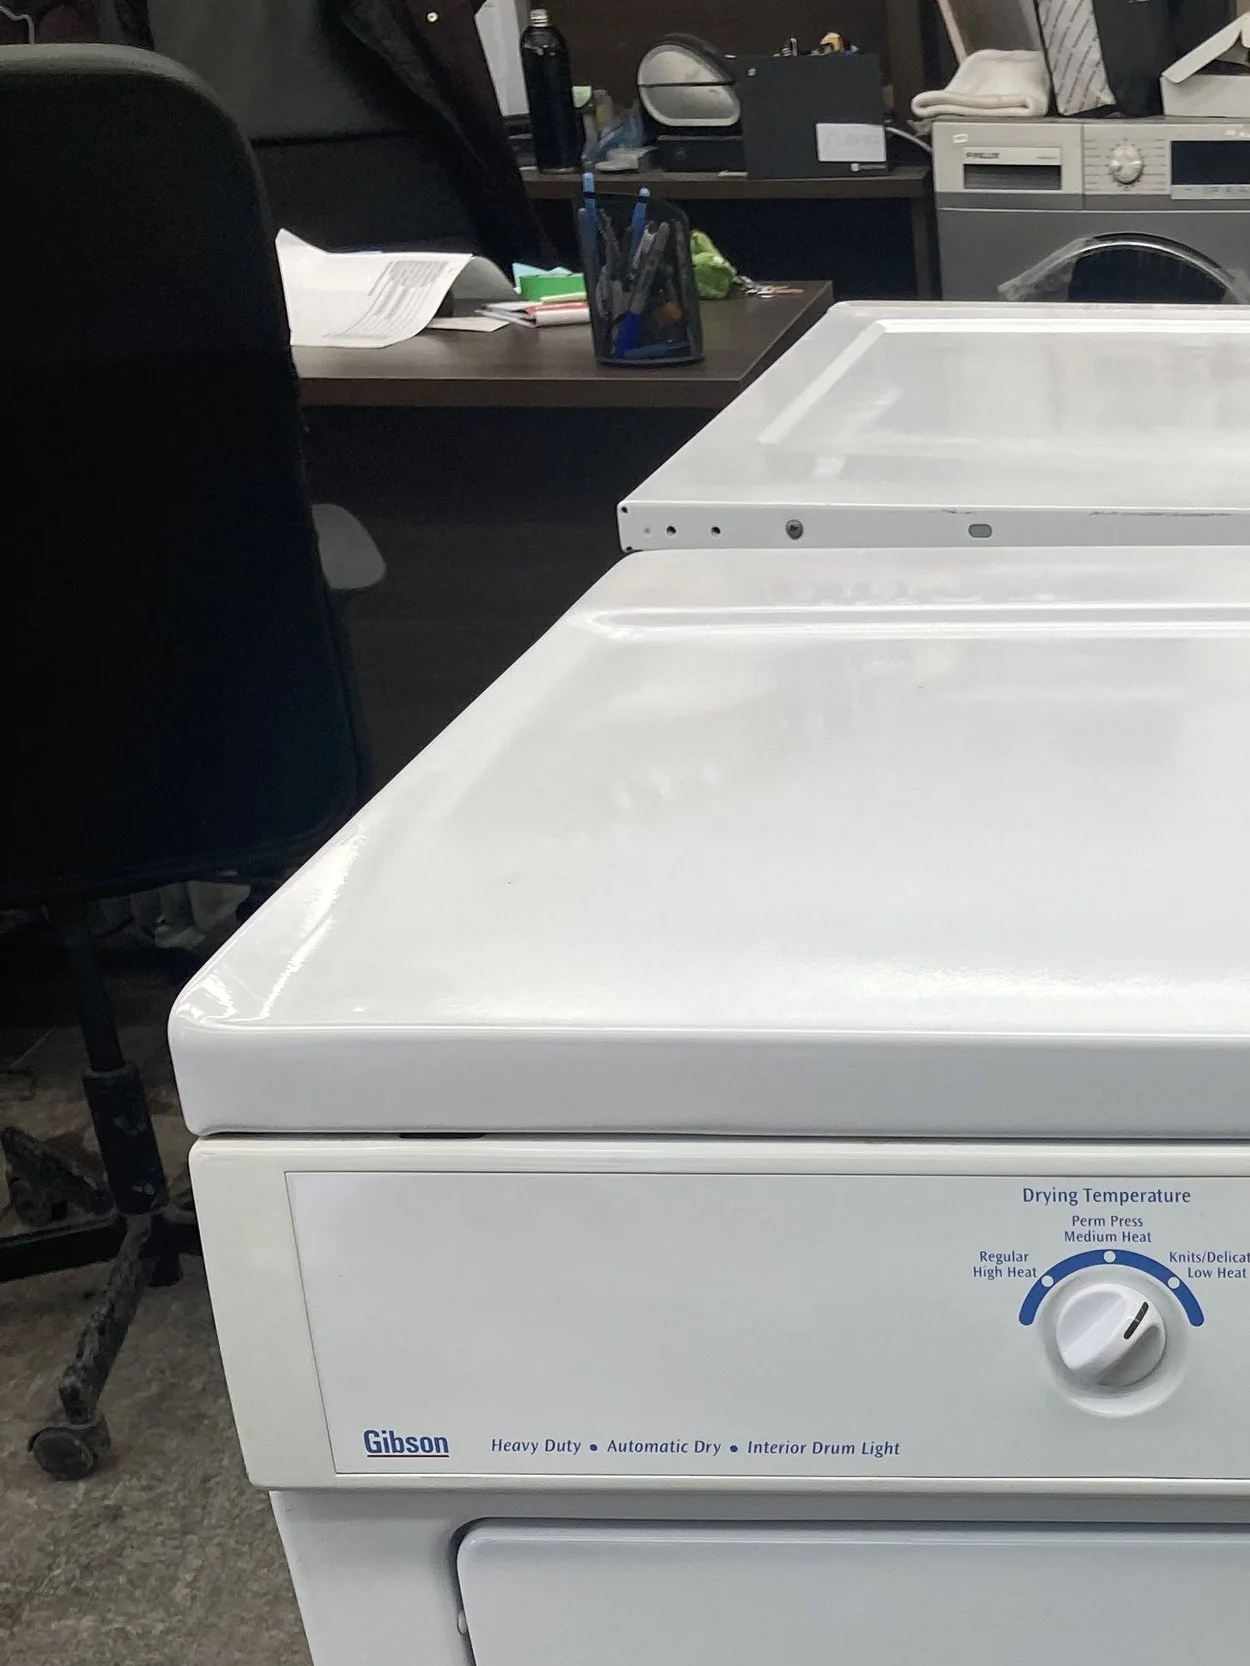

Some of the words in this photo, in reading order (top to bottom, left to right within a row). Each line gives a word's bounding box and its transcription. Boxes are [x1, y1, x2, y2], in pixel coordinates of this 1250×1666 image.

[1023, 1187, 1078, 1206] Drying
[1083, 1188, 1190, 1206] Temperature
[1073, 1216, 1105, 1226] Perm
[1111, 1216, 1143, 1227] Press
[1065, 1230, 1116, 1242] Medium
[1123, 1232, 1151, 1242] Heat
[980, 1251, 1028, 1265] Regular
[974, 1266, 1002, 1280] High
[1008, 1267, 1036, 1277] Heat
[1188, 1267, 1212, 1278] Low
[1218, 1267, 1246, 1278] Heat
[364, 1430, 449, 1453] Gibson
[492, 1439, 538, 1455] Heavy
[545, 1439, 581, 1455] Duty
[607, 1439, 688, 1453] Automatic
[695, 1441, 721, 1456] Dry
[748, 1441, 807, 1454] Interior
[813, 1442, 855, 1454] Drum
[862, 1441, 899, 1458] Light
